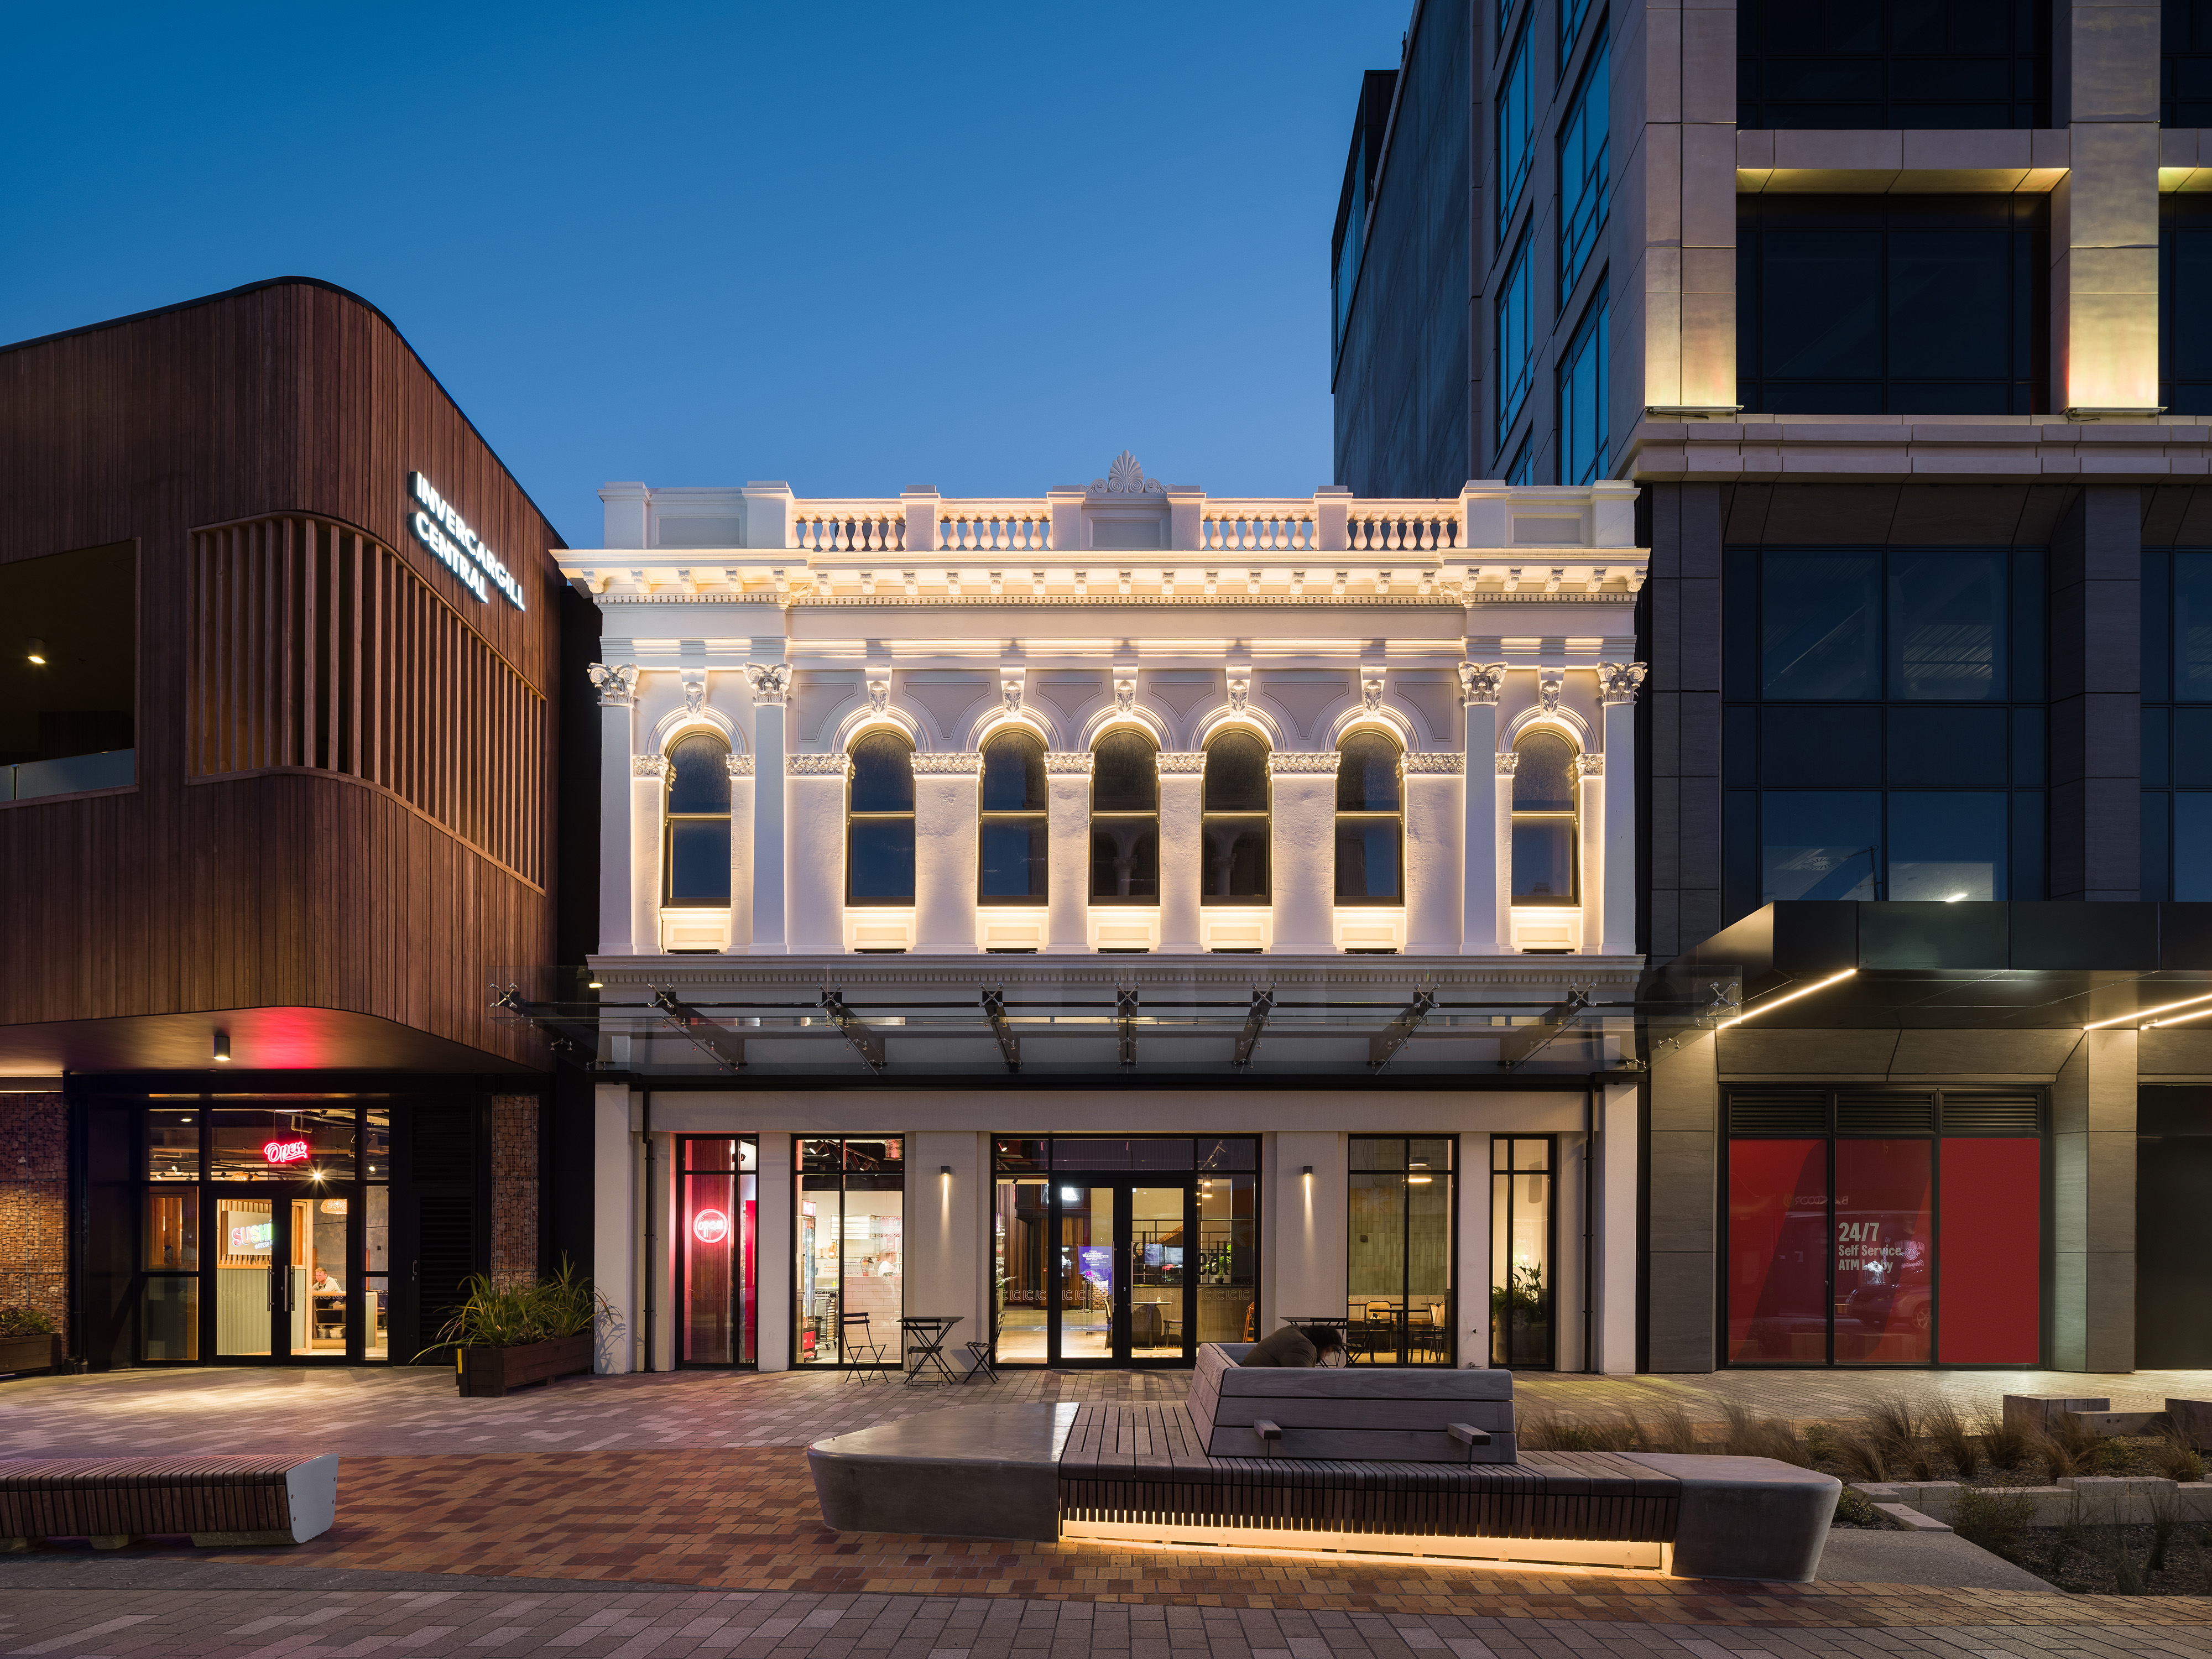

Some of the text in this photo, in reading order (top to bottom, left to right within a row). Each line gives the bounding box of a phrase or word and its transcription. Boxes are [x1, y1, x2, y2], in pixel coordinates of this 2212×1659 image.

[416, 471, 525, 612] INVERCARGILL
[415, 511, 489, 604] CENTRAL
[264, 1141, 307, 1162] Open
[697, 1220, 723, 1238] open
[1839, 1222, 1880, 1241] 24/7
[1838, 1244, 1859, 1256] Self
[1861, 1244, 1901, 1256] Service
[1838, 1259, 1893, 1274] ATM Lby
